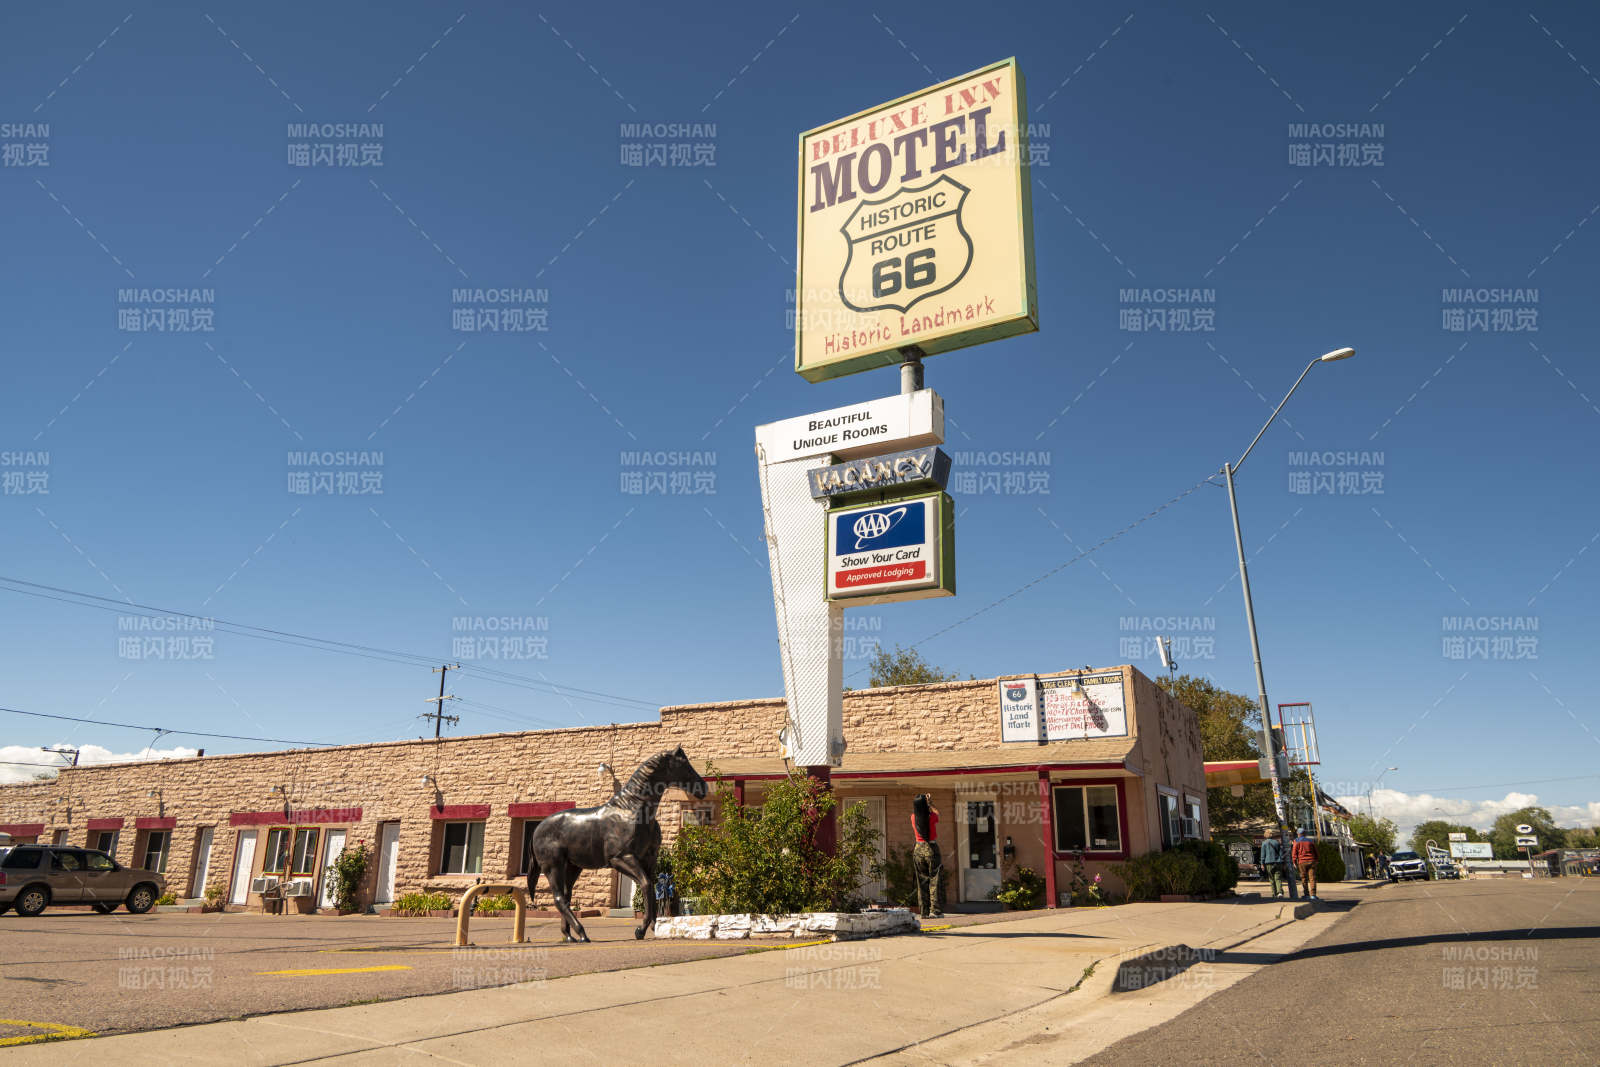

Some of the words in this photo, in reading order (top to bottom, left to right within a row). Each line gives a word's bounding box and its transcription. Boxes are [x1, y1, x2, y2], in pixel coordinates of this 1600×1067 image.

[811, 102, 927, 161] DELUXE
[944, 77, 1002, 116] INN
[810, 105, 1006, 213] MOTEL
[861, 192, 946, 231] HISTORIC
[871, 223, 936, 256] ROUTE
[872, 247, 936, 299] 66
[824, 322, 892, 355] Historic
[900, 296, 996, 336] Landmark
[793, 434, 838, 450] UNIQUE
[842, 424, 888, 441] ROOMS
[808, 411, 873, 432] BEAUTIFUL
[816, 454, 927, 491] VACANCY
[856, 514, 887, 538] AAA
[841, 557, 869, 568] Show
[871, 552, 894, 563] Your
[895, 547, 920, 559] Card
[846, 571, 882, 582] Approved
[883, 567, 914, 579] Lodging
[1012, 690, 1022, 698] 66
